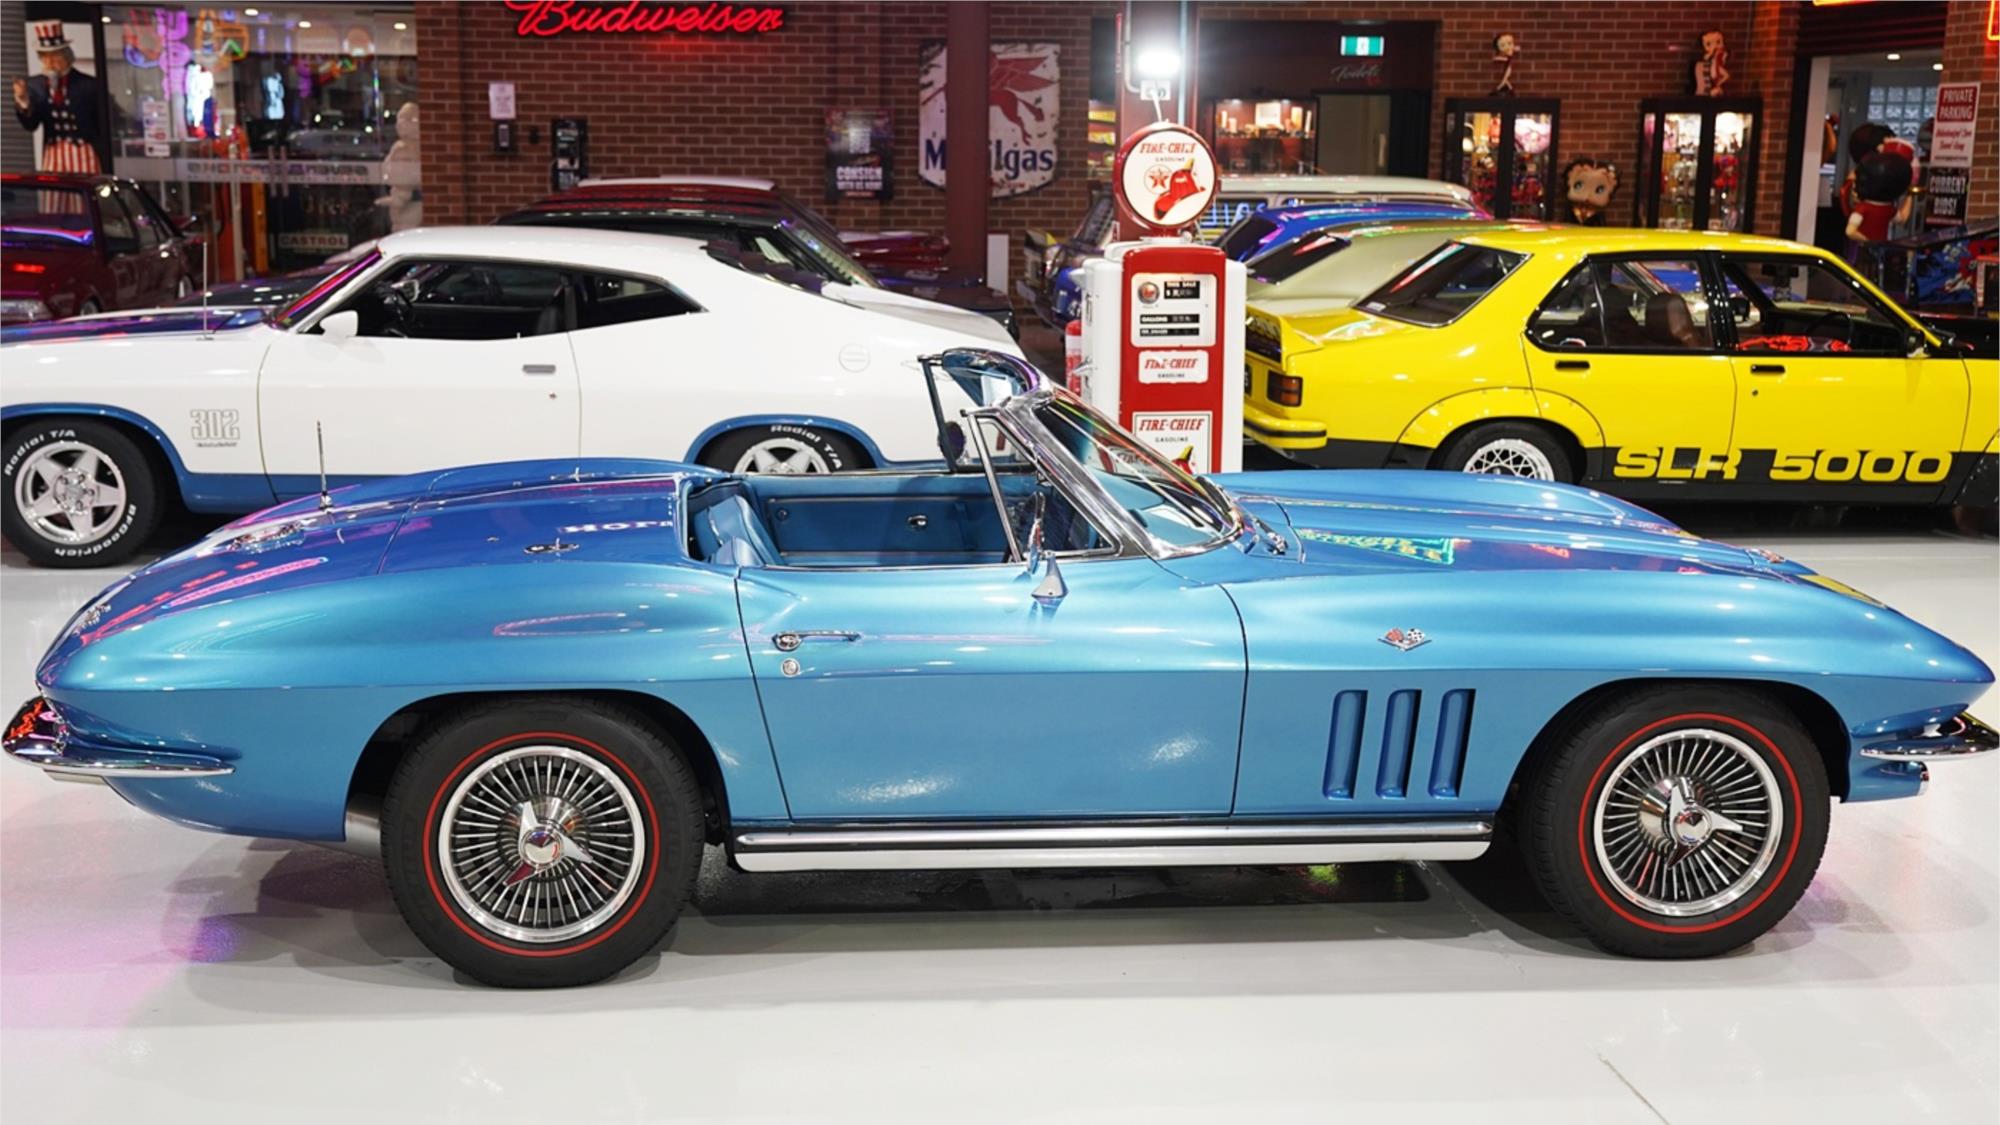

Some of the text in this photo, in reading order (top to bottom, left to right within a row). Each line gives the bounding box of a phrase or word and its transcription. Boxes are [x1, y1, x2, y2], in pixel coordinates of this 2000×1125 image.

[505, 0, 783, 36] Budweiser
[1943, 88, 1974, 103] PRIVATE
[1939, 105, 1973, 121] PARKING
[836, 166, 883, 180] CONSIGN
[925, 138, 1053, 180] Mlgas
[1930, 176, 1966, 194] CURRENT
[280, 234, 346, 246] CASTROL
[190, 409, 240, 440] 302
[1139, 418, 1205, 431] FIRE-CHIEF
[4, 429, 76, 476] Radial T/A
[771, 424, 843, 469] Radial T/A
[1613, 446, 1953, 484] SLR 5000
[54, 503, 137, 558] BFGoodrich
